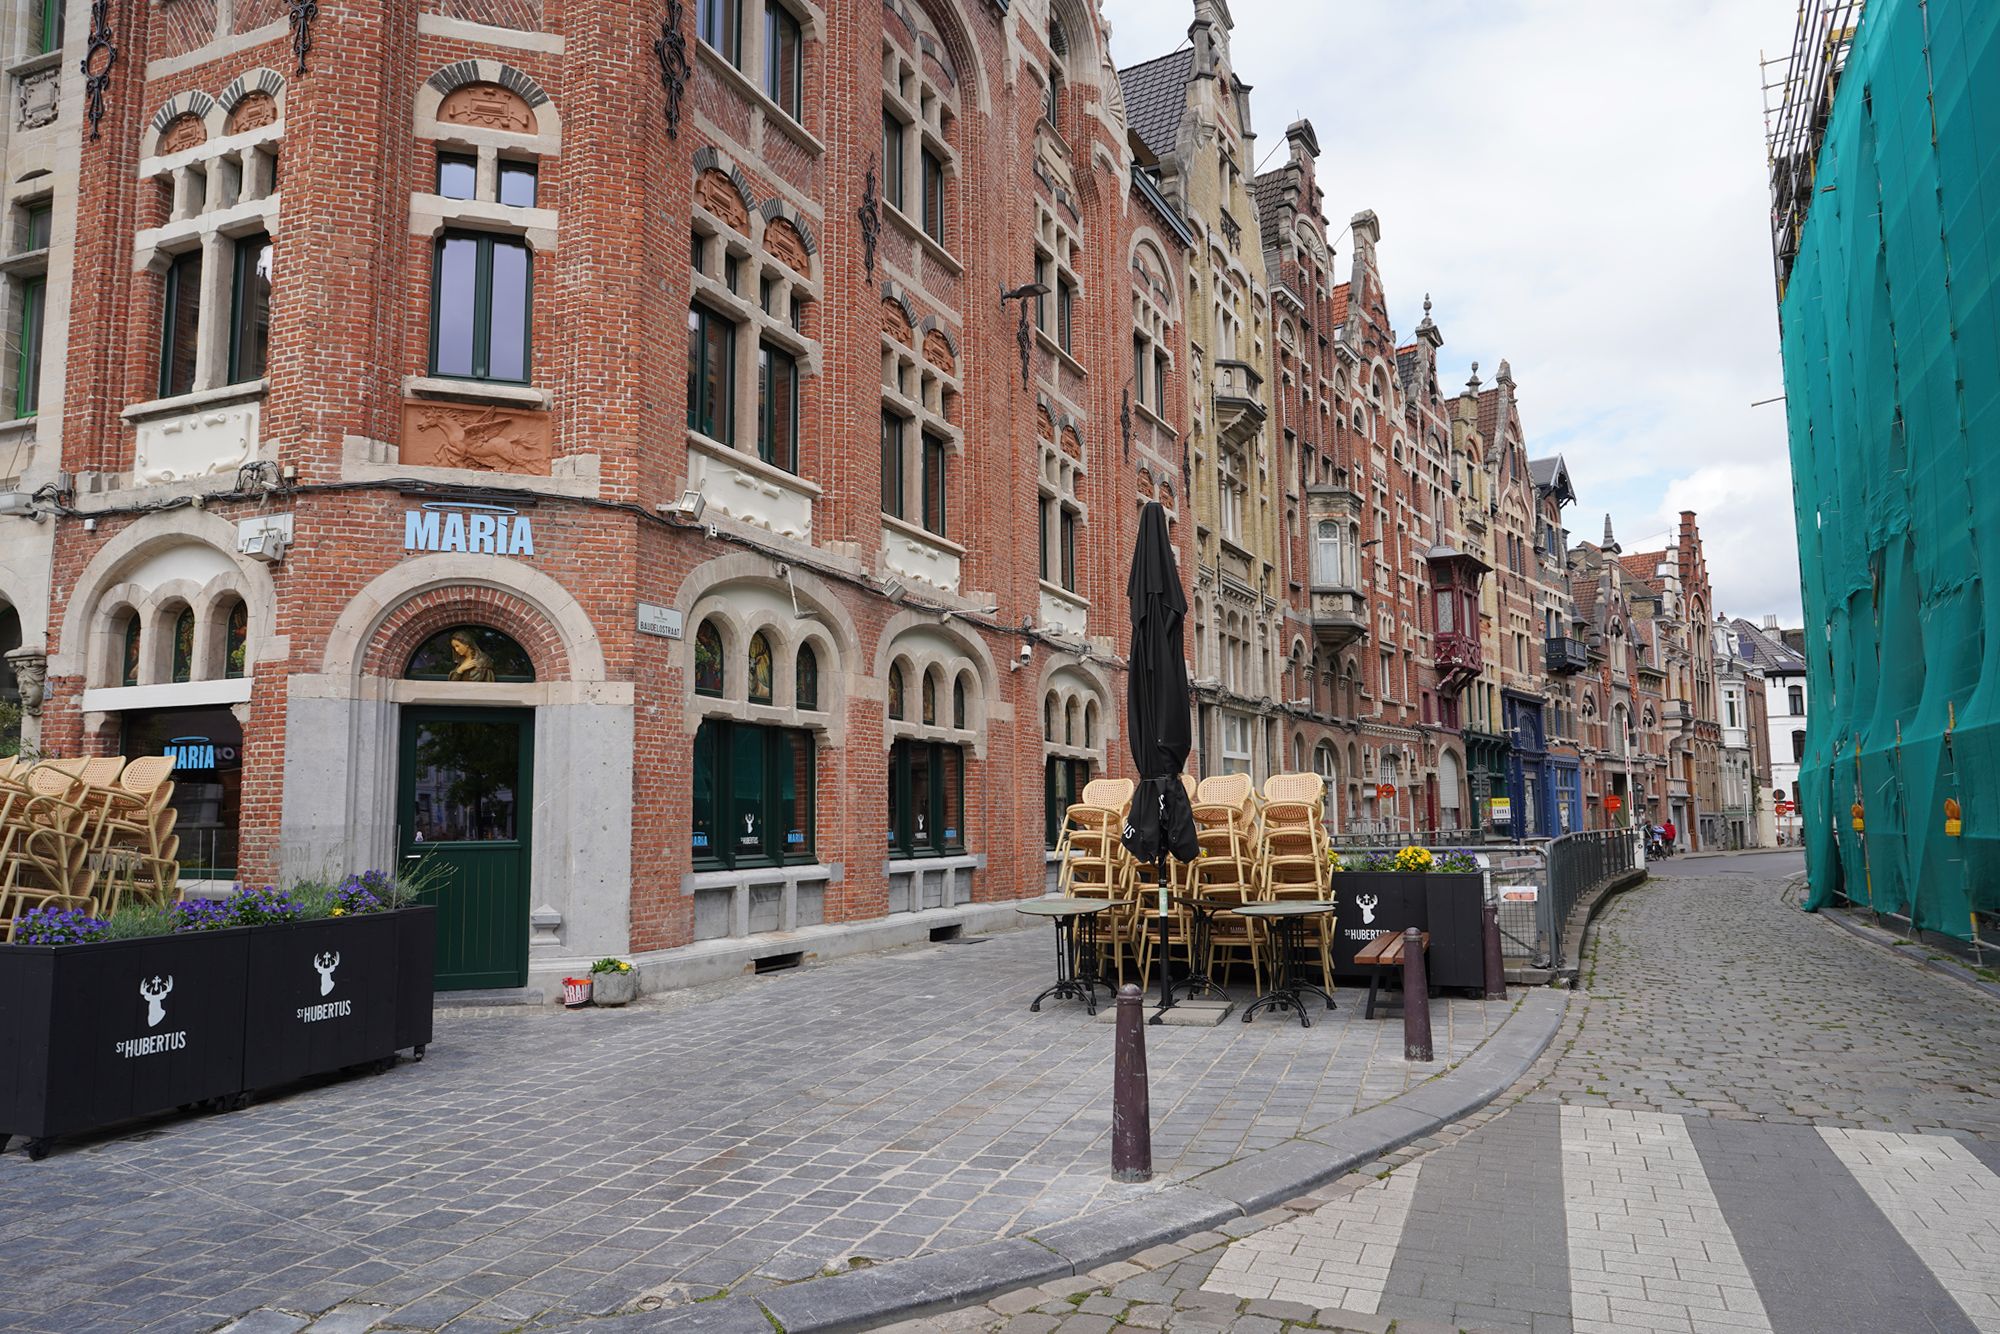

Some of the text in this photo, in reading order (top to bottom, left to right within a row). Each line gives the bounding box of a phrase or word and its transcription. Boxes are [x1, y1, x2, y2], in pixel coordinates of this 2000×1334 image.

[640, 620, 680, 636] BAUDELOSTRAAT
[1350, 929, 1391, 940] HUBERT
[304, 1000, 351, 1023] HUBERTUS
[125, 1031, 187, 1058] HUBERTUS
